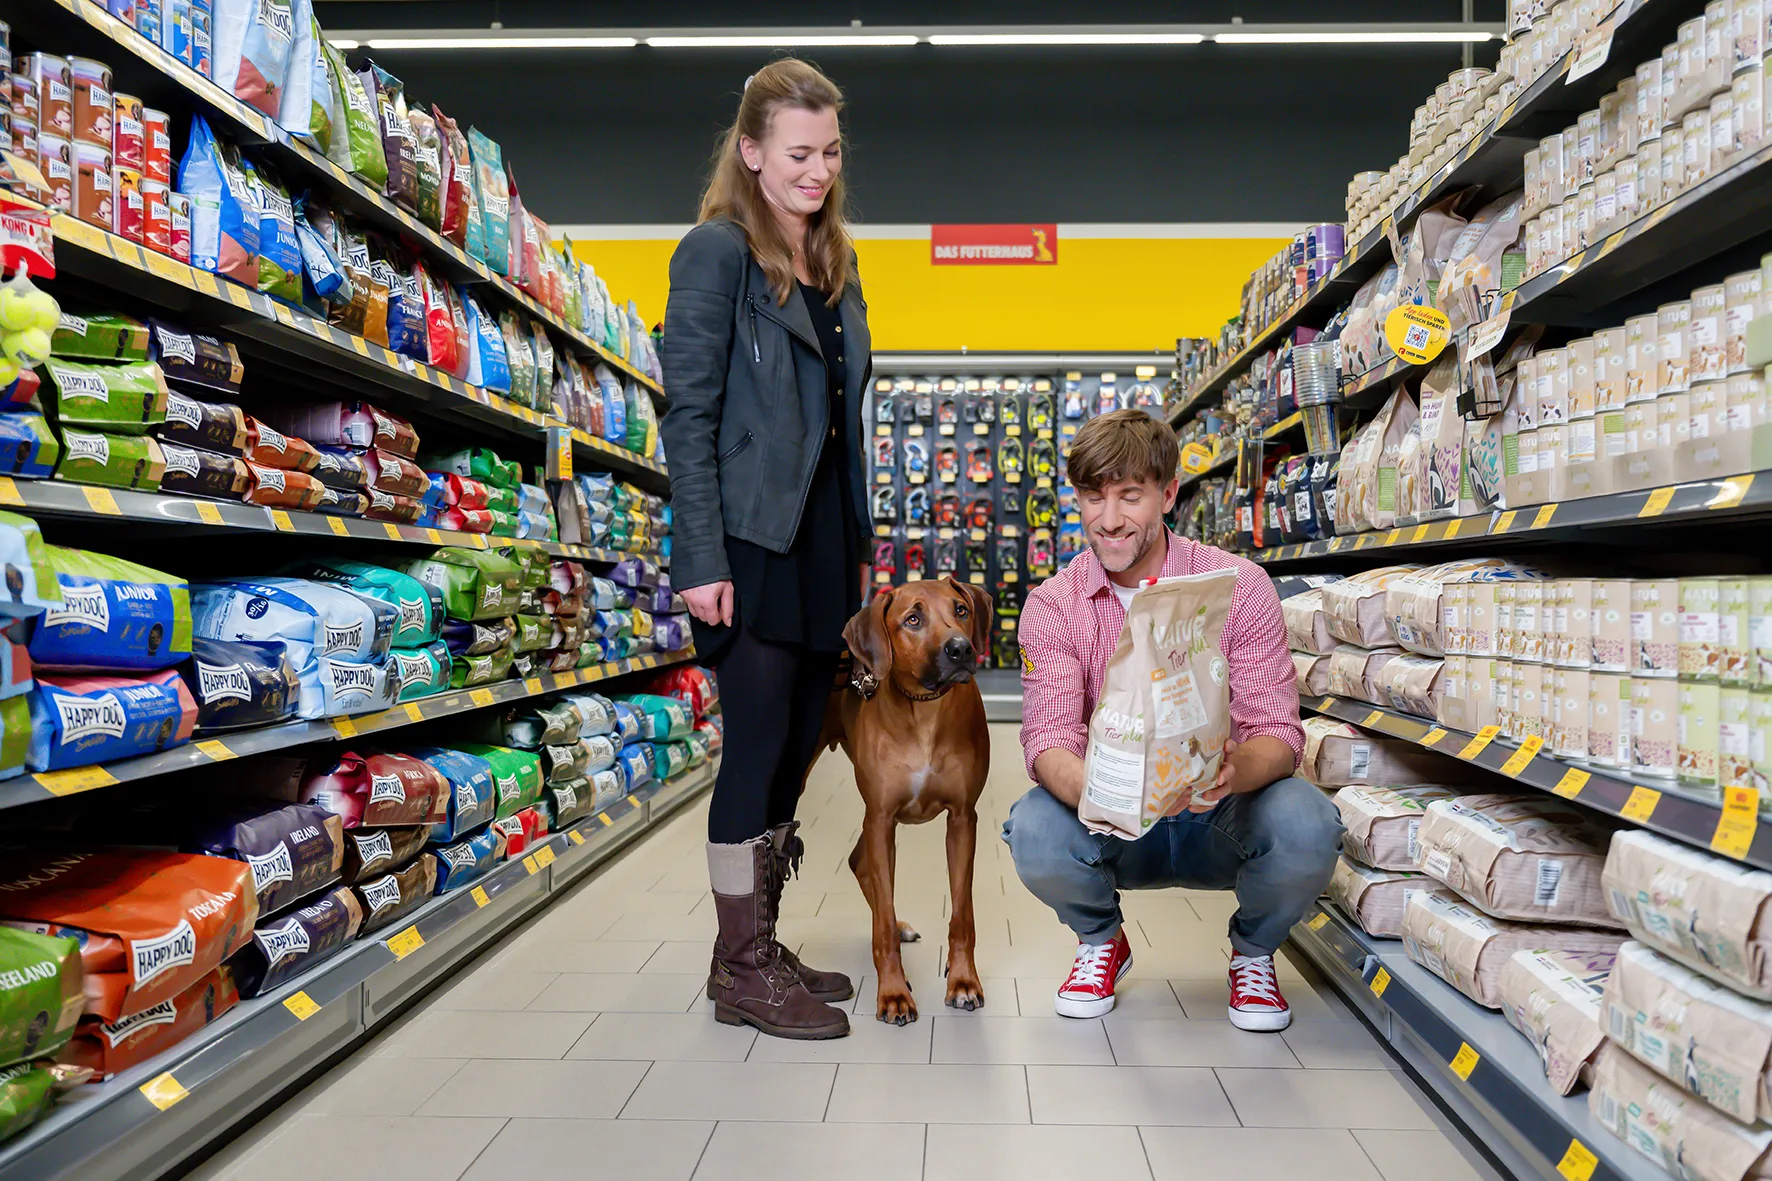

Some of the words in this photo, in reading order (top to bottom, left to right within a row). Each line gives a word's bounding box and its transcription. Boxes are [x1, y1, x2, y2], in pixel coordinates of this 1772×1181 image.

[1, 216, 28, 235] KONG
[935, 246, 959, 258] DAS
[960, 245, 1034, 259] FUTTERHAUS
[1403, 312, 1426, 325] TIERISCH
[1426, 319, 1446, 332] SPAREN
[1405, 305, 1416, 315] App
[1417, 309, 1433, 320] laden
[1433, 316, 1445, 325] UND
[163, 334, 182, 351] HAPPY
[182, 340, 195, 357] DOG
[58, 373, 87, 391] HAPPY
[88, 374, 107, 395] DOG
[168, 401, 189, 417] HAPPY
[189, 406, 200, 424] DOG
[68, 437, 93, 455] HAPPY
[94, 439, 109, 459] DOG
[167, 456, 186, 469] HAPPY
[186, 457, 199, 471] DOG
[115, 585, 158, 601] JUNIOR
[84, 596, 106, 619] DOG
[326, 630, 349, 653] HAPPY
[348, 628, 363, 648] DOG
[1152, 614, 1207, 650] NATUR
[1167, 650, 1188, 671] Tier
[1188, 635, 1211, 664] plus
[202, 671, 230, 692] HAPPY
[231, 670, 250, 691] DOG
[333, 669, 360, 689] HAPPY
[360, 669, 376, 688] DOG
[123, 685, 164, 704] JUNIOR
[64, 706, 101, 731] HAPPY
[103, 703, 125, 727] DOG
[1099, 705, 1145, 733] NATUR
[1105, 727, 1123, 740] Tier
[374, 778, 393, 798] HAPPY
[392, 777, 405, 797] DOG
[289, 826, 320, 845] IRELAND
[359, 844, 378, 863] HAPPY
[377, 836, 390, 855] DOG
[253, 861, 277, 886] HAPPY
[277, 850, 291, 873] DOG
[187, 891, 237, 921] TOSCANA
[367, 888, 387, 908] HAPPY
[386, 882, 399, 902] DOG
[265, 936, 291, 958] HAPPY
[290, 927, 308, 950] DOG
[137, 947, 173, 978] HAPPY
[174, 930, 194, 958] DOG
